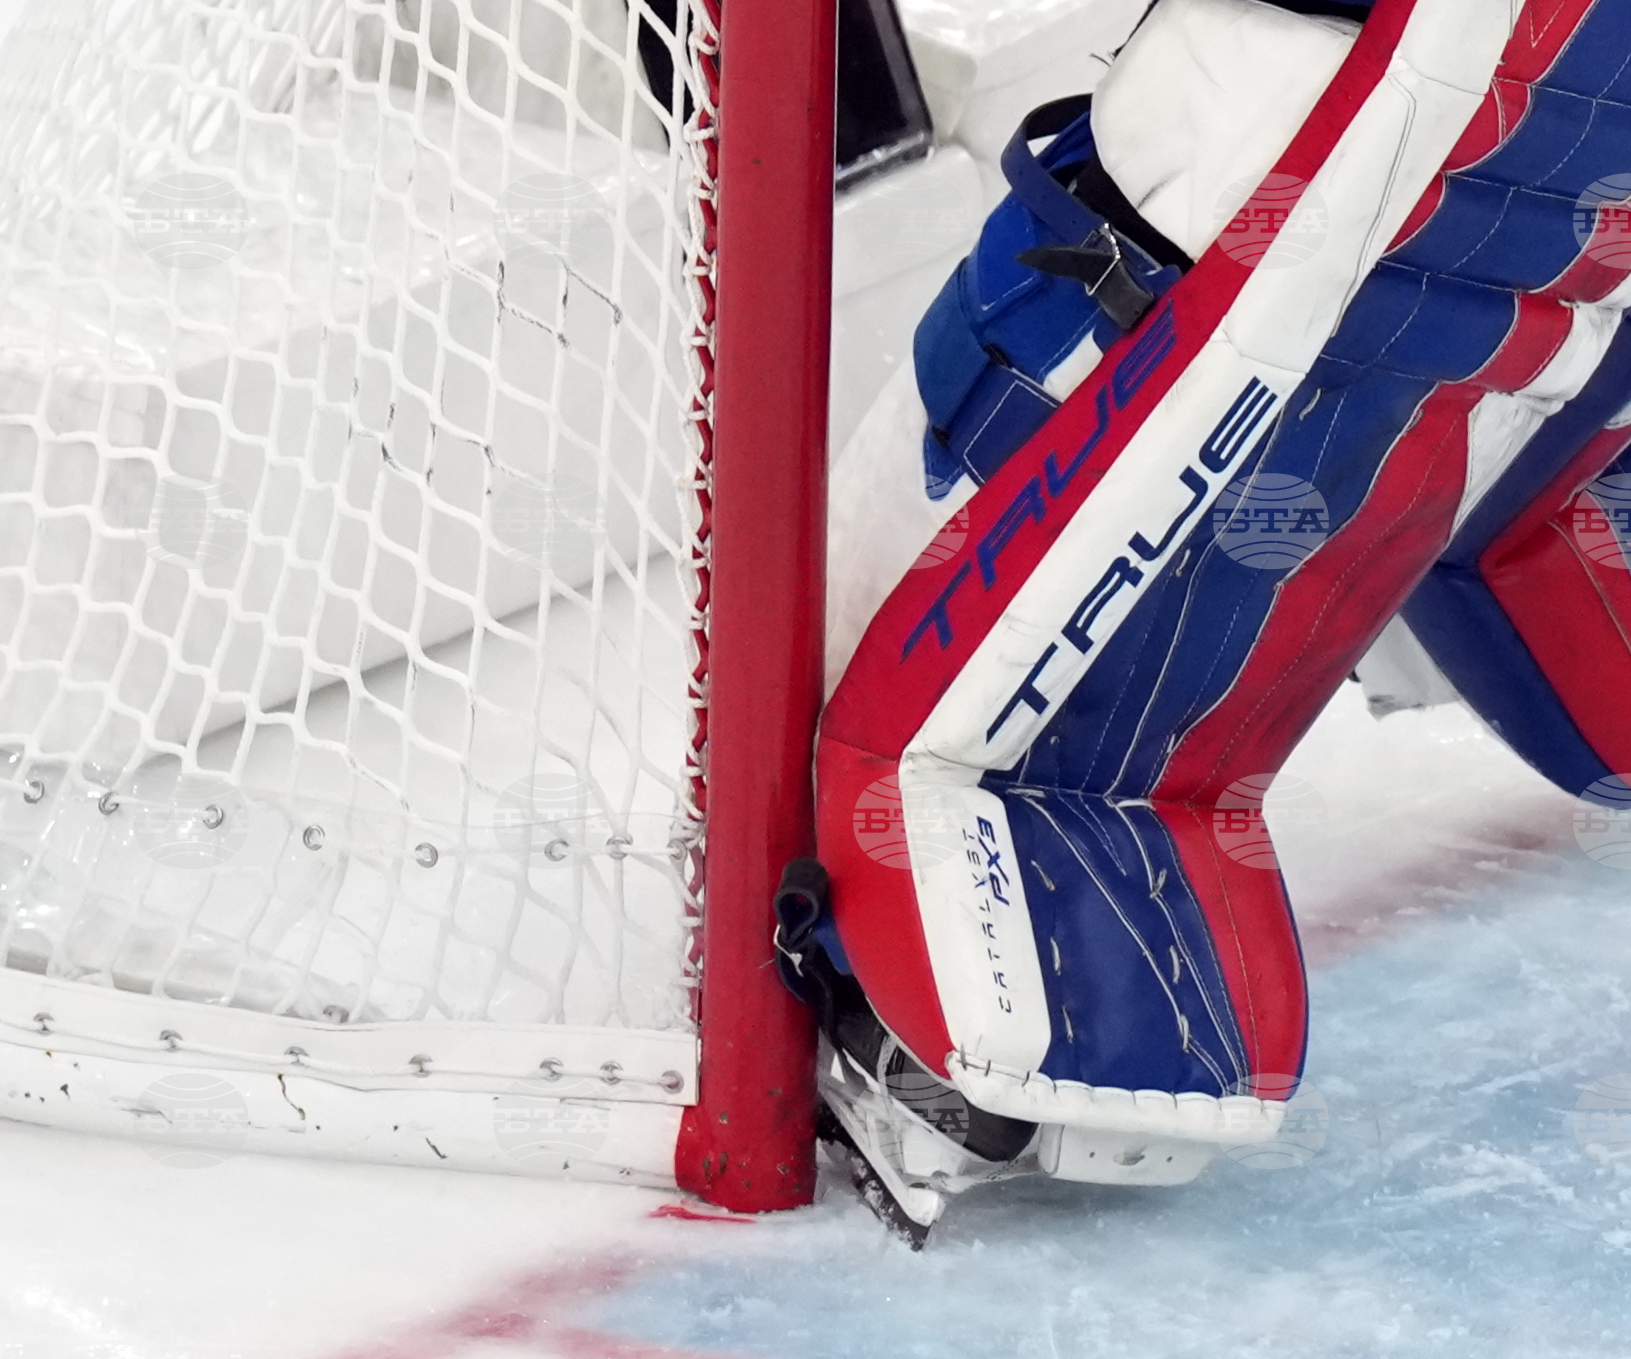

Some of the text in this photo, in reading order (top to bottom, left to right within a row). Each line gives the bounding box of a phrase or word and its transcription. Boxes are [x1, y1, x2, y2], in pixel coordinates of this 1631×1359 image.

[900, 298, 1177, 665] TRUE
[986, 375, 1278, 746] TRUE
[961, 827, 1013, 1014] CATALYST
[975, 815, 1011, 907] PX3
